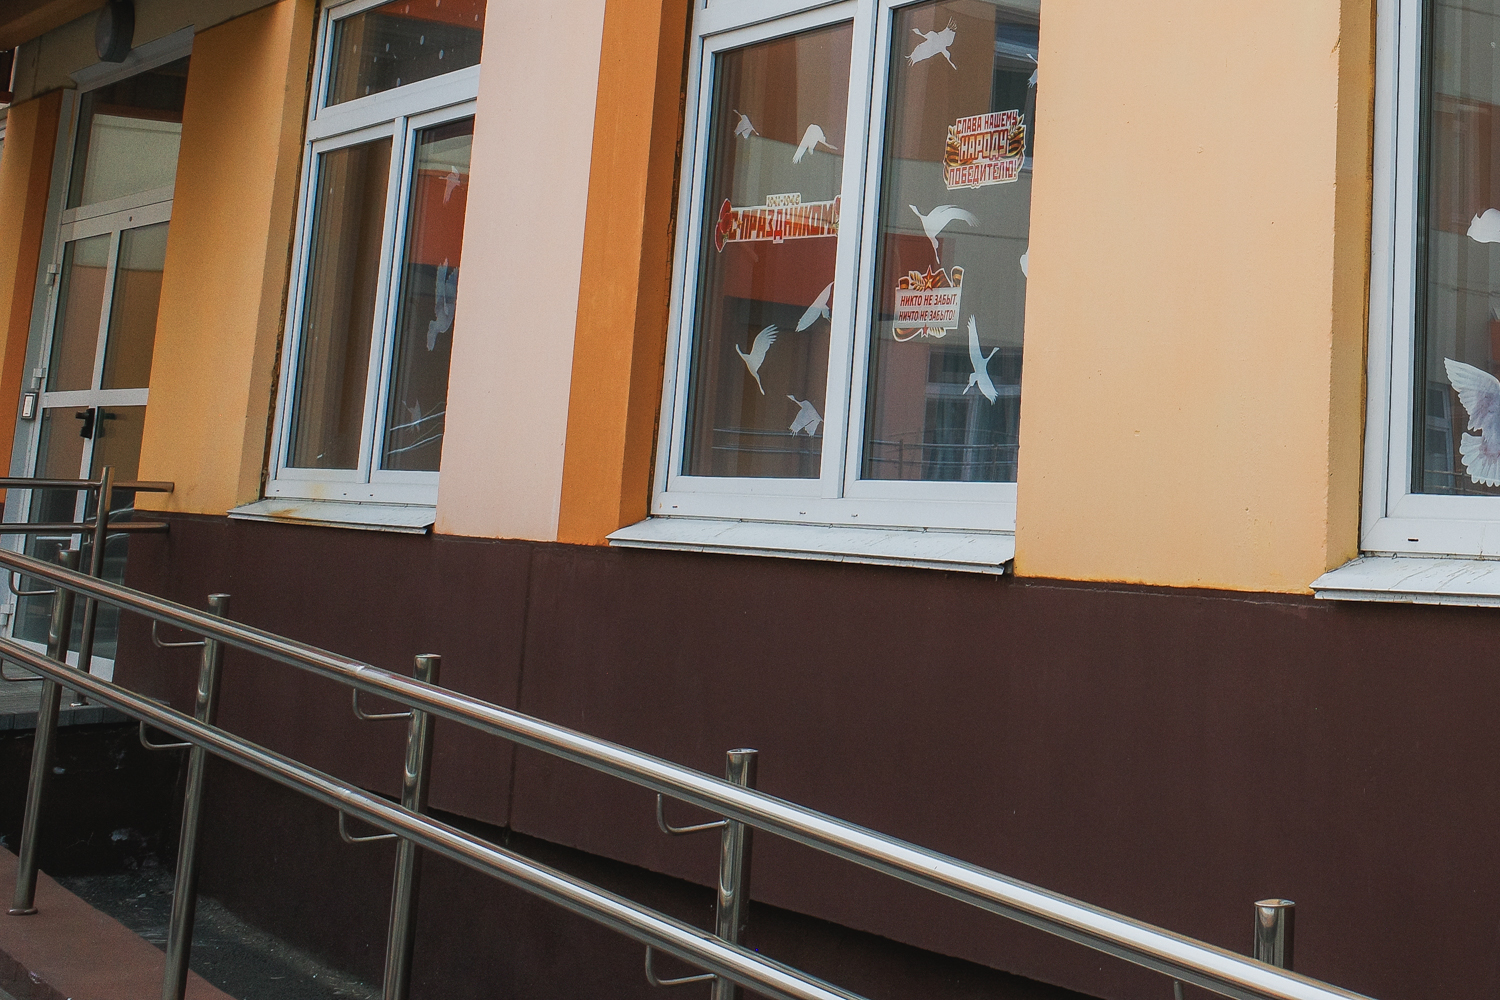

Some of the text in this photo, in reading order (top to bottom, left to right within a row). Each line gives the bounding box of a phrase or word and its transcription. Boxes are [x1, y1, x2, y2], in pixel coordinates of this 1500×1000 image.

[956, 111, 1018, 134] СЛАВА НАШЕМУ
[960, 130, 1009, 160] НАРОДУ
[948, 160, 1017, 186] ПОБЕДИТЕЛЮ!
[900, 295, 923, 307] НИКТО
[923, 294, 933, 306] НЕ
[899, 310, 919, 322] НИЧТО
[920, 310, 928, 321] НЕ
